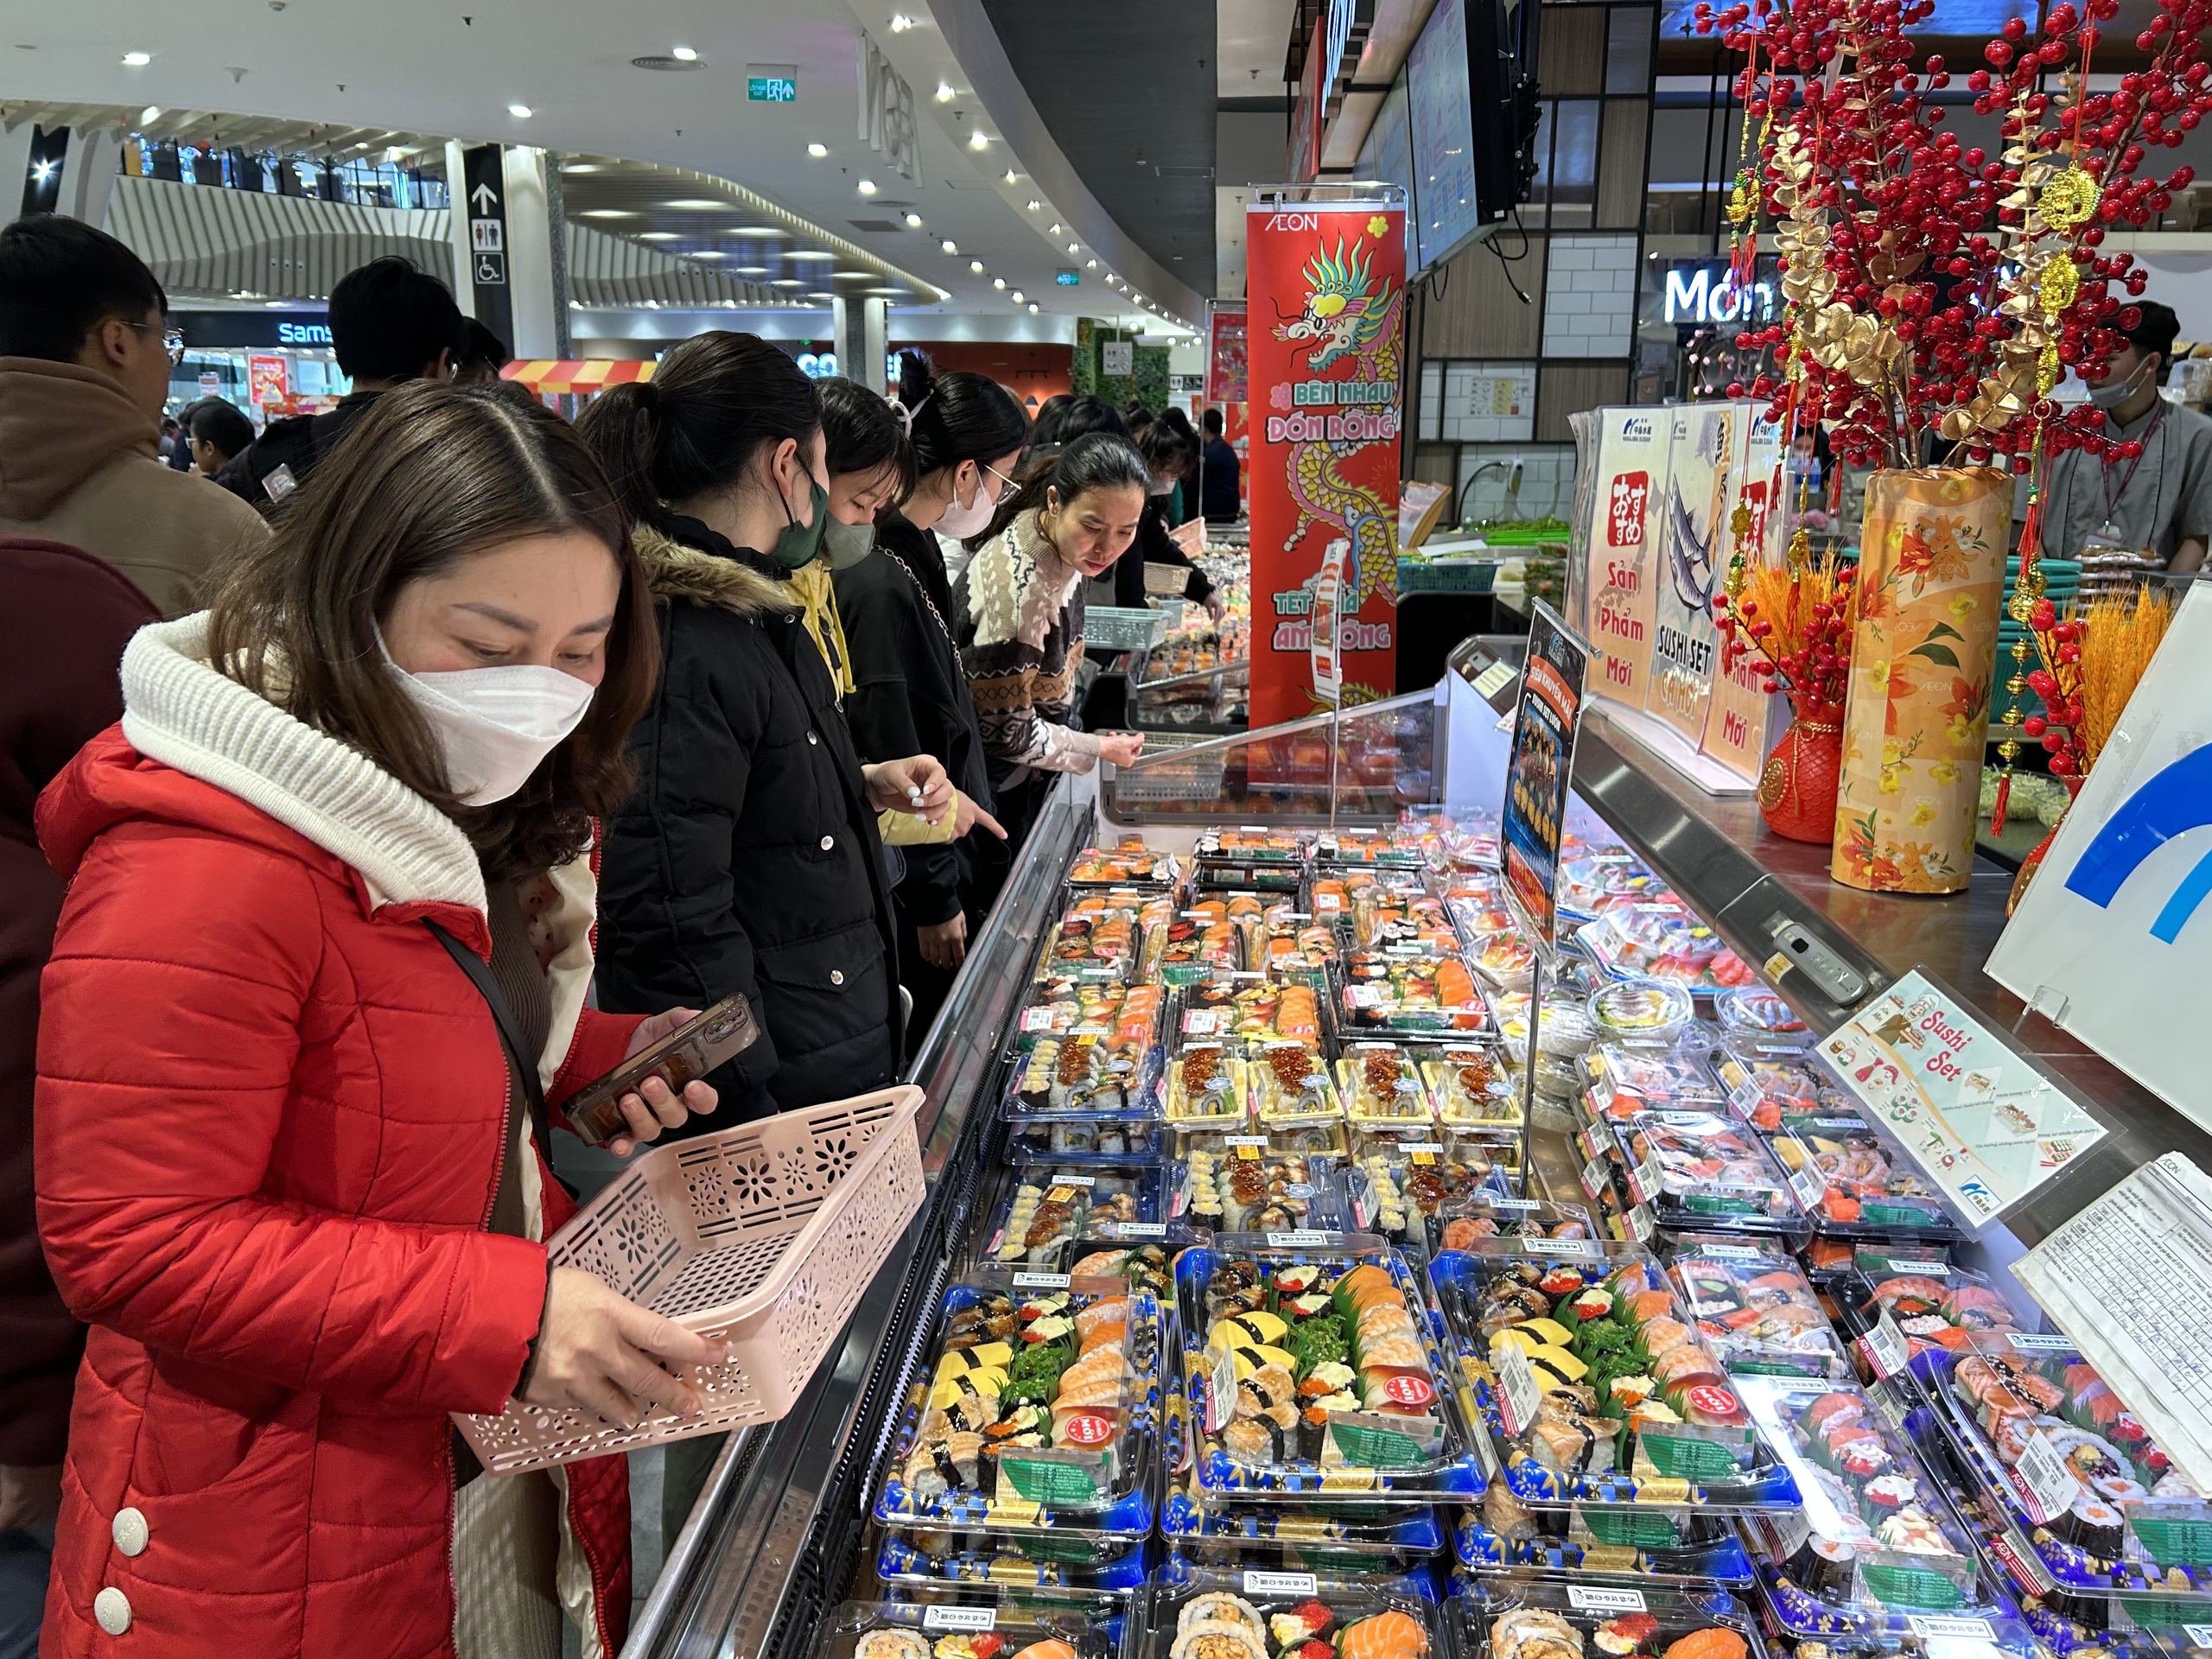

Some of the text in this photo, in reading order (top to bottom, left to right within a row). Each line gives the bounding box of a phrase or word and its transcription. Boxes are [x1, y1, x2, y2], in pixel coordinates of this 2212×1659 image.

[1664, 268, 1774, 323] Món
[1294, 380, 1393, 405] BÊN NHAU
[1268, 409, 1395, 441] ĐÓN RỒNG
[1608, 561, 1637, 592] Sản
[1274, 588, 1313, 614] TẾT
[1600, 608, 1643, 641] Phẩm
[1658, 625, 1711, 676] SUSHI SET
[1605, 654, 1633, 688] Mới
[1723, 709, 1747, 750] Mới
[1920, 1010, 1973, 1053] Sushi
[1925, 1050, 1963, 1083] Set
[2011, 1471, 2027, 1495] AEON
[1993, 1541, 2013, 1561] AEON
